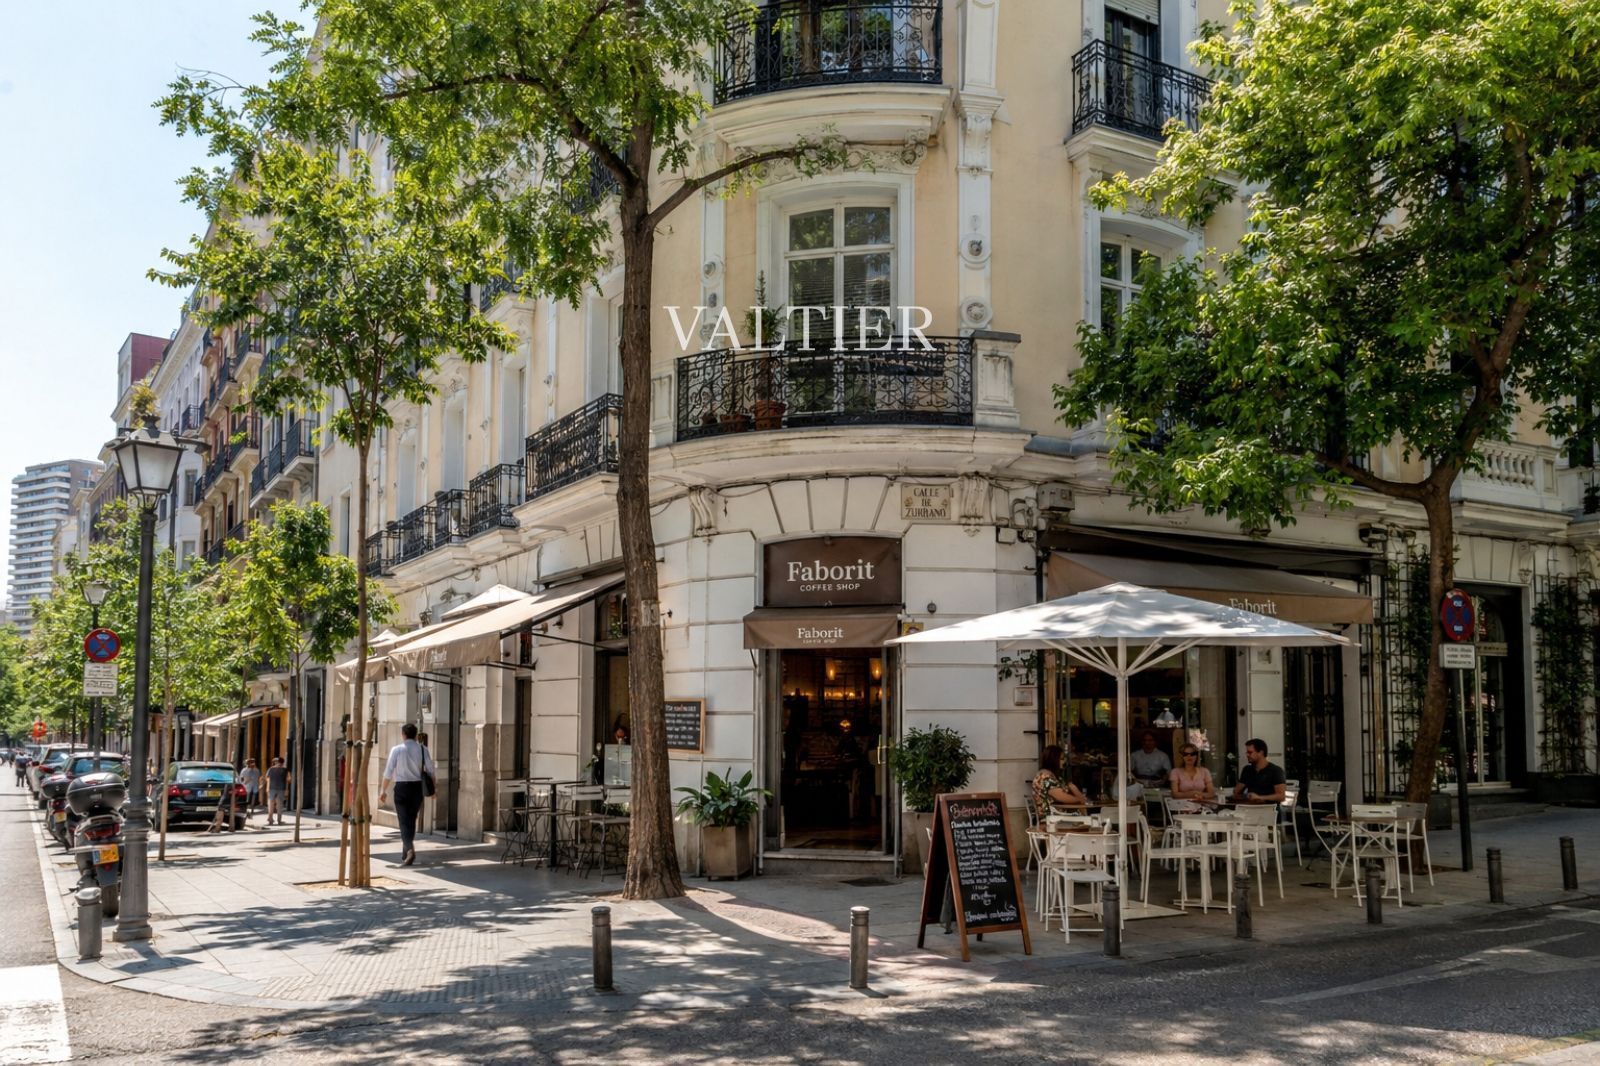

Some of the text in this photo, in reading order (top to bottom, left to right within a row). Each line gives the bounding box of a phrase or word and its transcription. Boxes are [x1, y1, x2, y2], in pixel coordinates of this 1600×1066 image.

[787, 558, 875, 582] Faborit
[800, 582, 861, 592] COFFEE SHOP
[797, 627, 845, 639] Faborit
